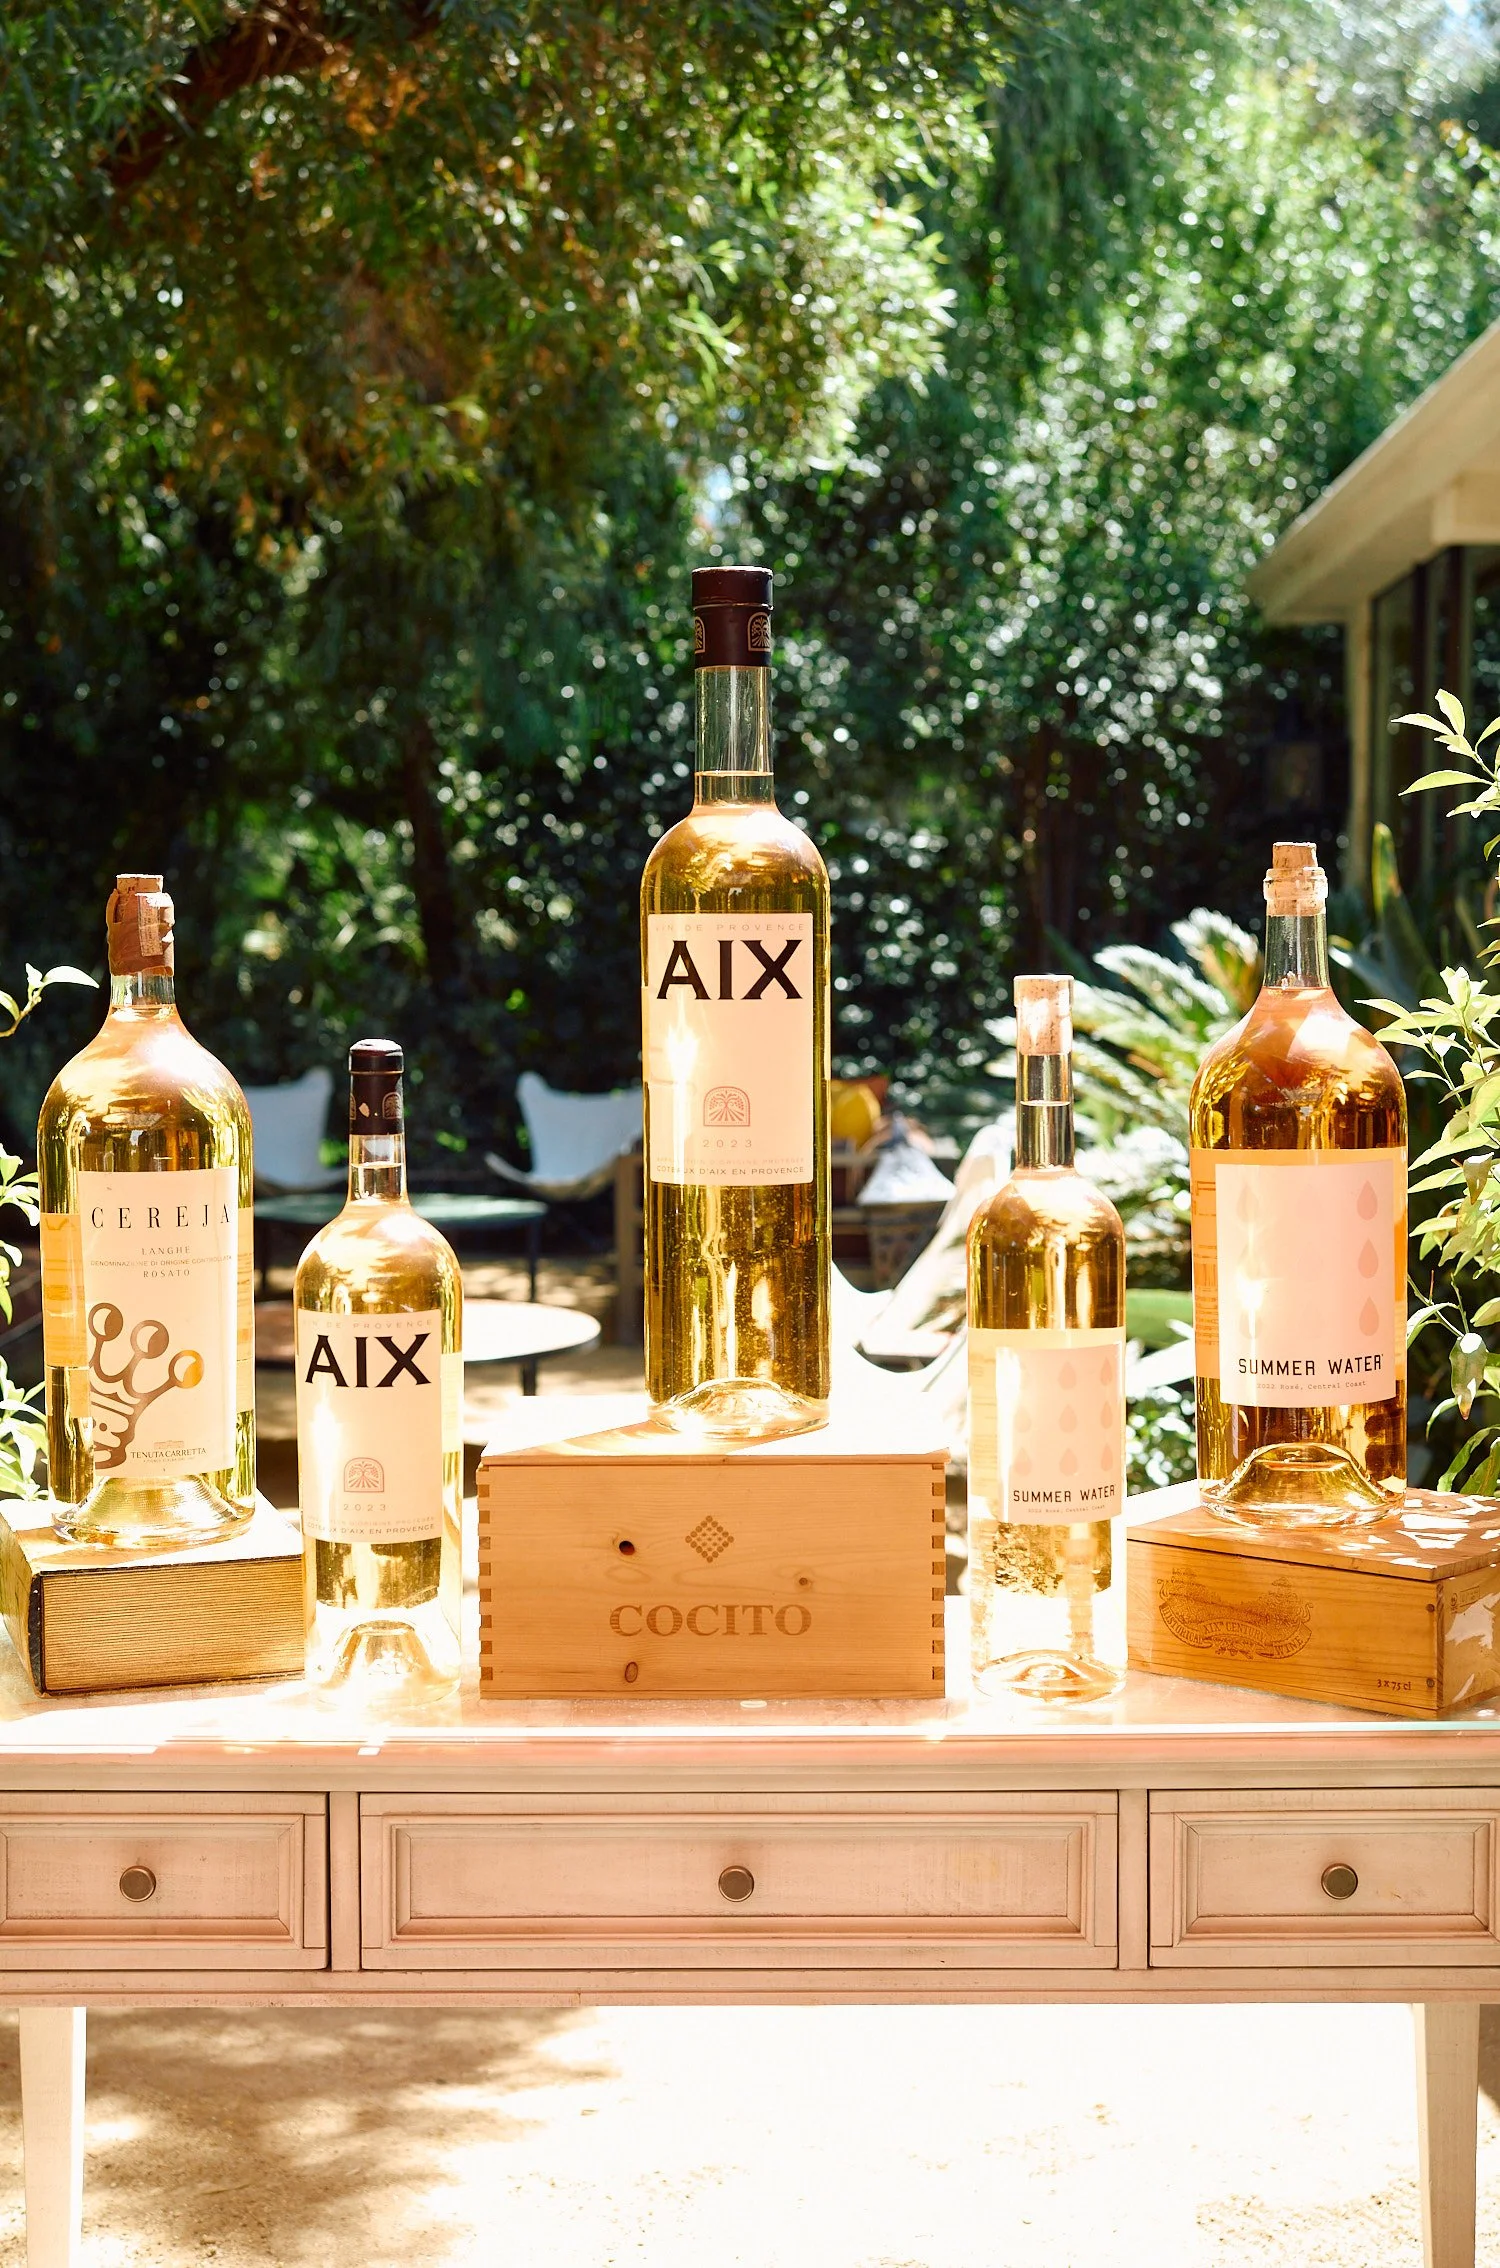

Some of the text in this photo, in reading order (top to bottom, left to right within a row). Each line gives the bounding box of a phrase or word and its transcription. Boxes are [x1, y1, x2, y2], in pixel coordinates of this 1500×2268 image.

[717, 923, 805, 931] PROVENCE
[656, 940, 803, 1000] AIX
[703, 1140, 752, 1148] 2023
[699, 1167, 727, 1175] D'AIX
[751, 1166, 805, 1175] PROVENCE
[91, 1203, 230, 1229] CEREJA
[141, 1246, 191, 1256] LANGHE
[160, 1259, 190, 1267] ORIGINE
[143, 1269, 190, 1279] ROSATO
[353, 1320, 432, 1329] PROVENCE
[305, 1333, 432, 1388] AIX
[1238, 1354, 1382, 1376] SUMMER WATER
[1307, 1382, 1341, 1390] Central
[1345, 1380, 1366, 1388] Coast
[130, 1447, 207, 1459] TENUTA CARRETTA
[1013, 1484, 1115, 1502] SUMMER WATER
[343, 1503, 387, 1511] 2023
[386, 1523, 435, 1534] PROVENCE
[610, 1604, 812, 1636] COCITO
[1377, 1679, 1382, 1688] 3
[1391, 1681, 1400, 1690] 75
[1403, 1681, 1411, 1690] cl
